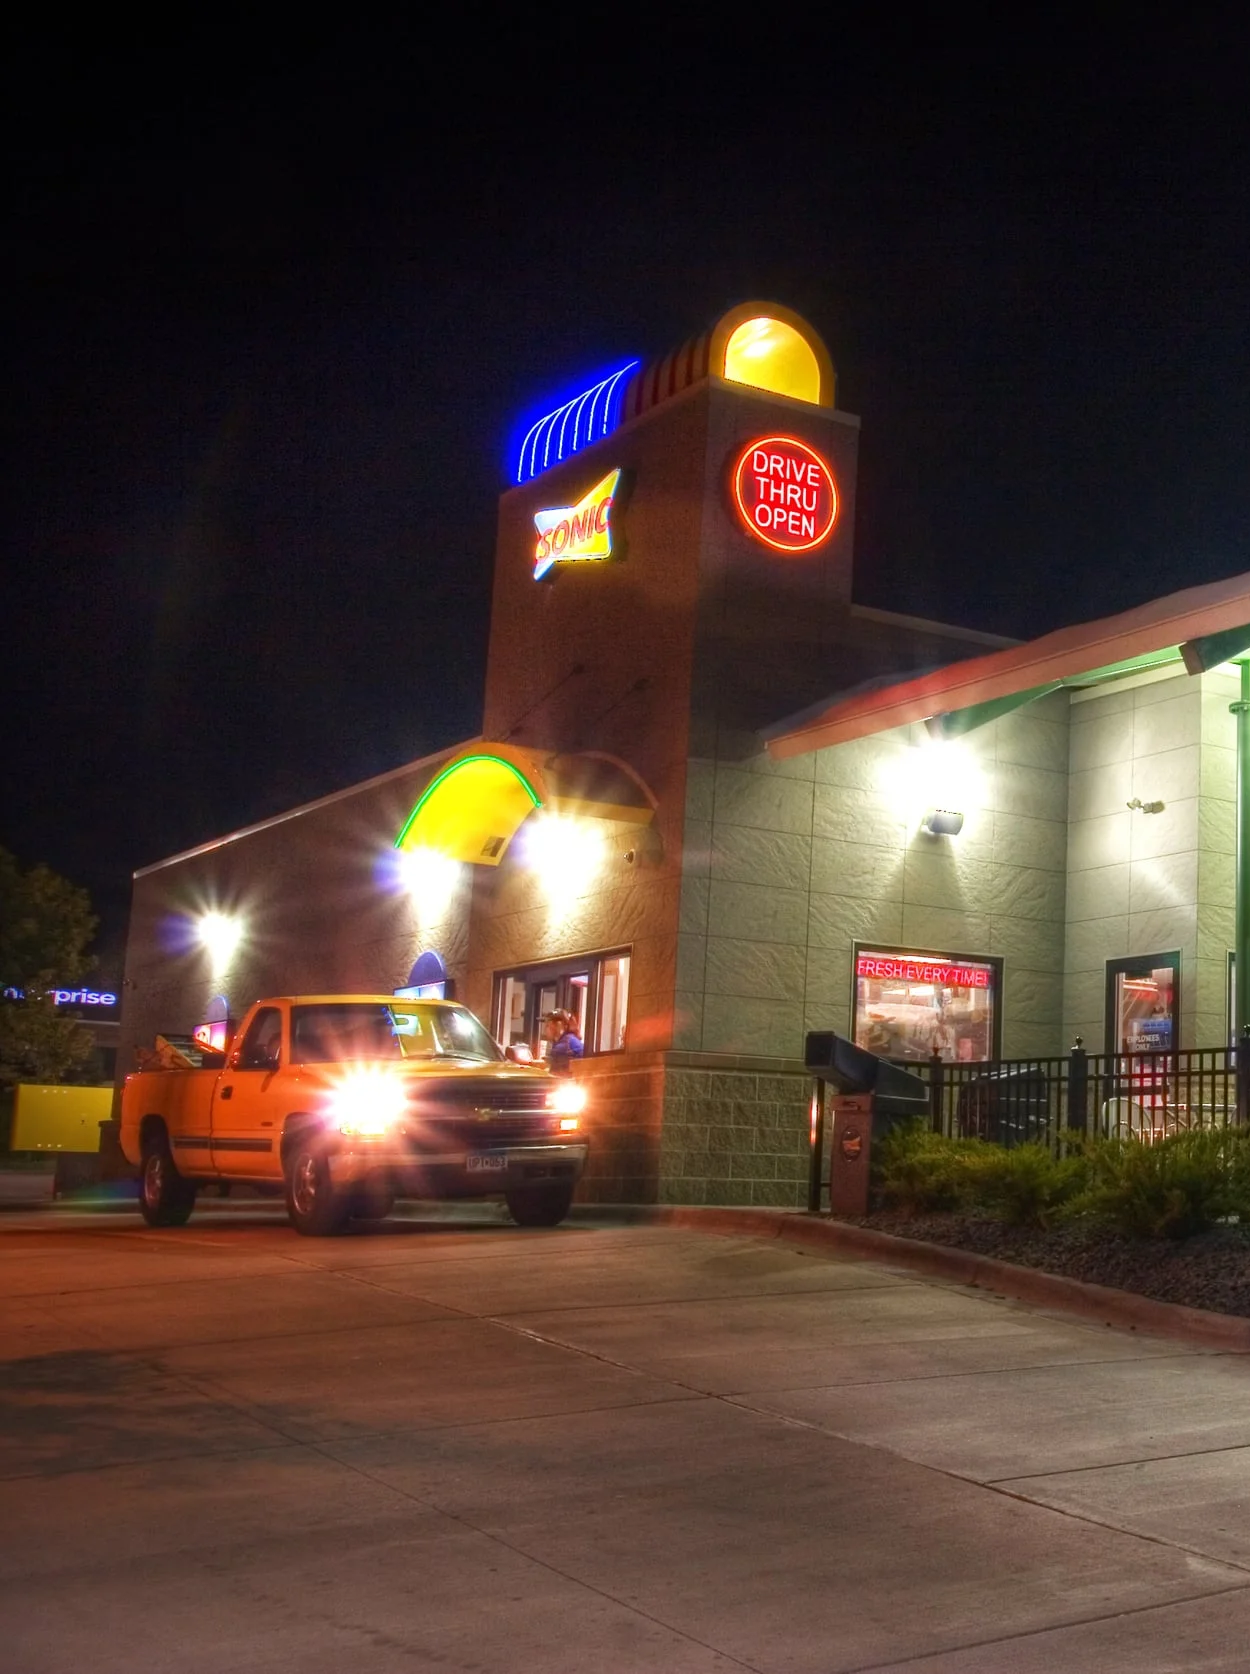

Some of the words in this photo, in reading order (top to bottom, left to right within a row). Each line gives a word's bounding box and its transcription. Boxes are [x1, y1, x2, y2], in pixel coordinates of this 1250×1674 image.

[753, 450, 820, 487] DRIVE
[755, 476, 817, 511] THRU
[536, 496, 614, 564] SONIC
[755, 503, 815, 538] OPEN
[857, 959, 903, 978] FRESH
[906, 964, 950, 982] EVERY
[953, 968, 988, 986] TIME!
